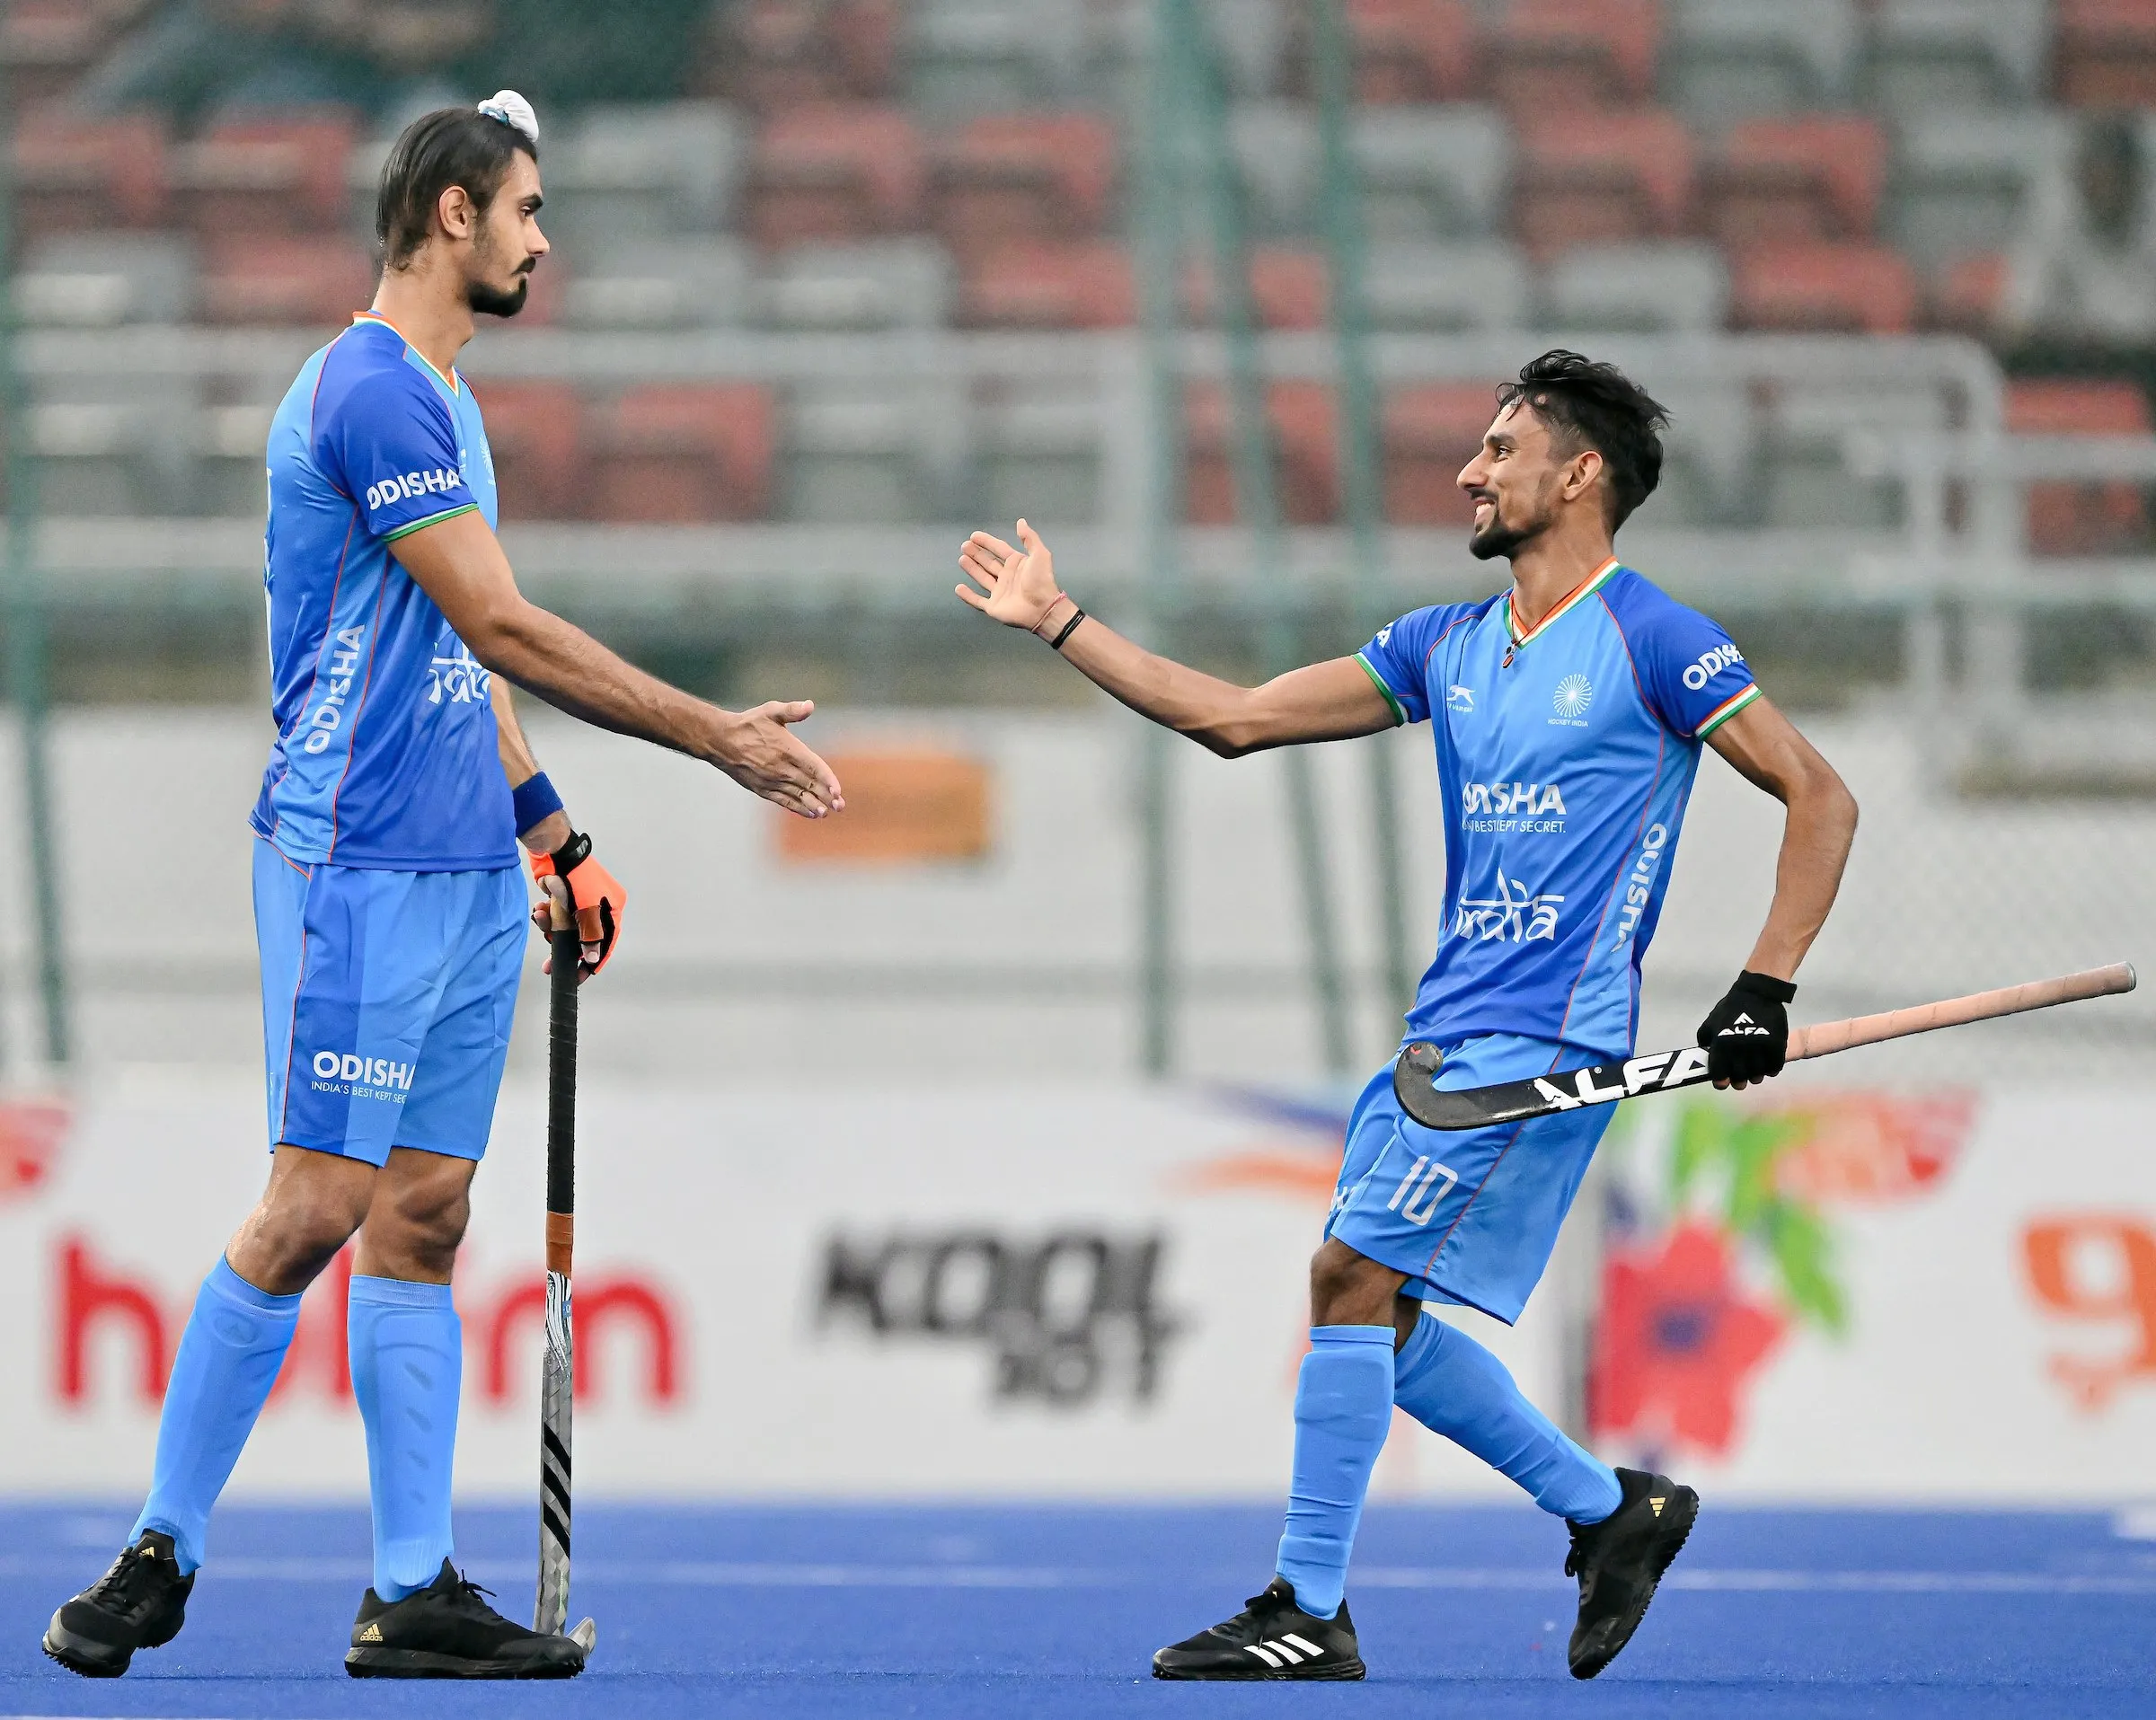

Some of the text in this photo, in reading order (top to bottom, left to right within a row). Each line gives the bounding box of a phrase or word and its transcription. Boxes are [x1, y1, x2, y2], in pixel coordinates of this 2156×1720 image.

[367, 468, 463, 510] ODISHA
[304, 624, 366, 754] ODISHA
[1496, 820, 1518, 833] EPT
[1519, 820, 1567, 834] SECRET.
[1717, 1026, 1771, 1036] ALFA
[311, 1081, 349, 1095] INDIA'S
[352, 1086, 374, 1098] BEST
[375, 1089, 393, 1101] KEPT
[1533, 1046, 1711, 1111] ALFA
[1386, 1155, 1459, 1226] 10
